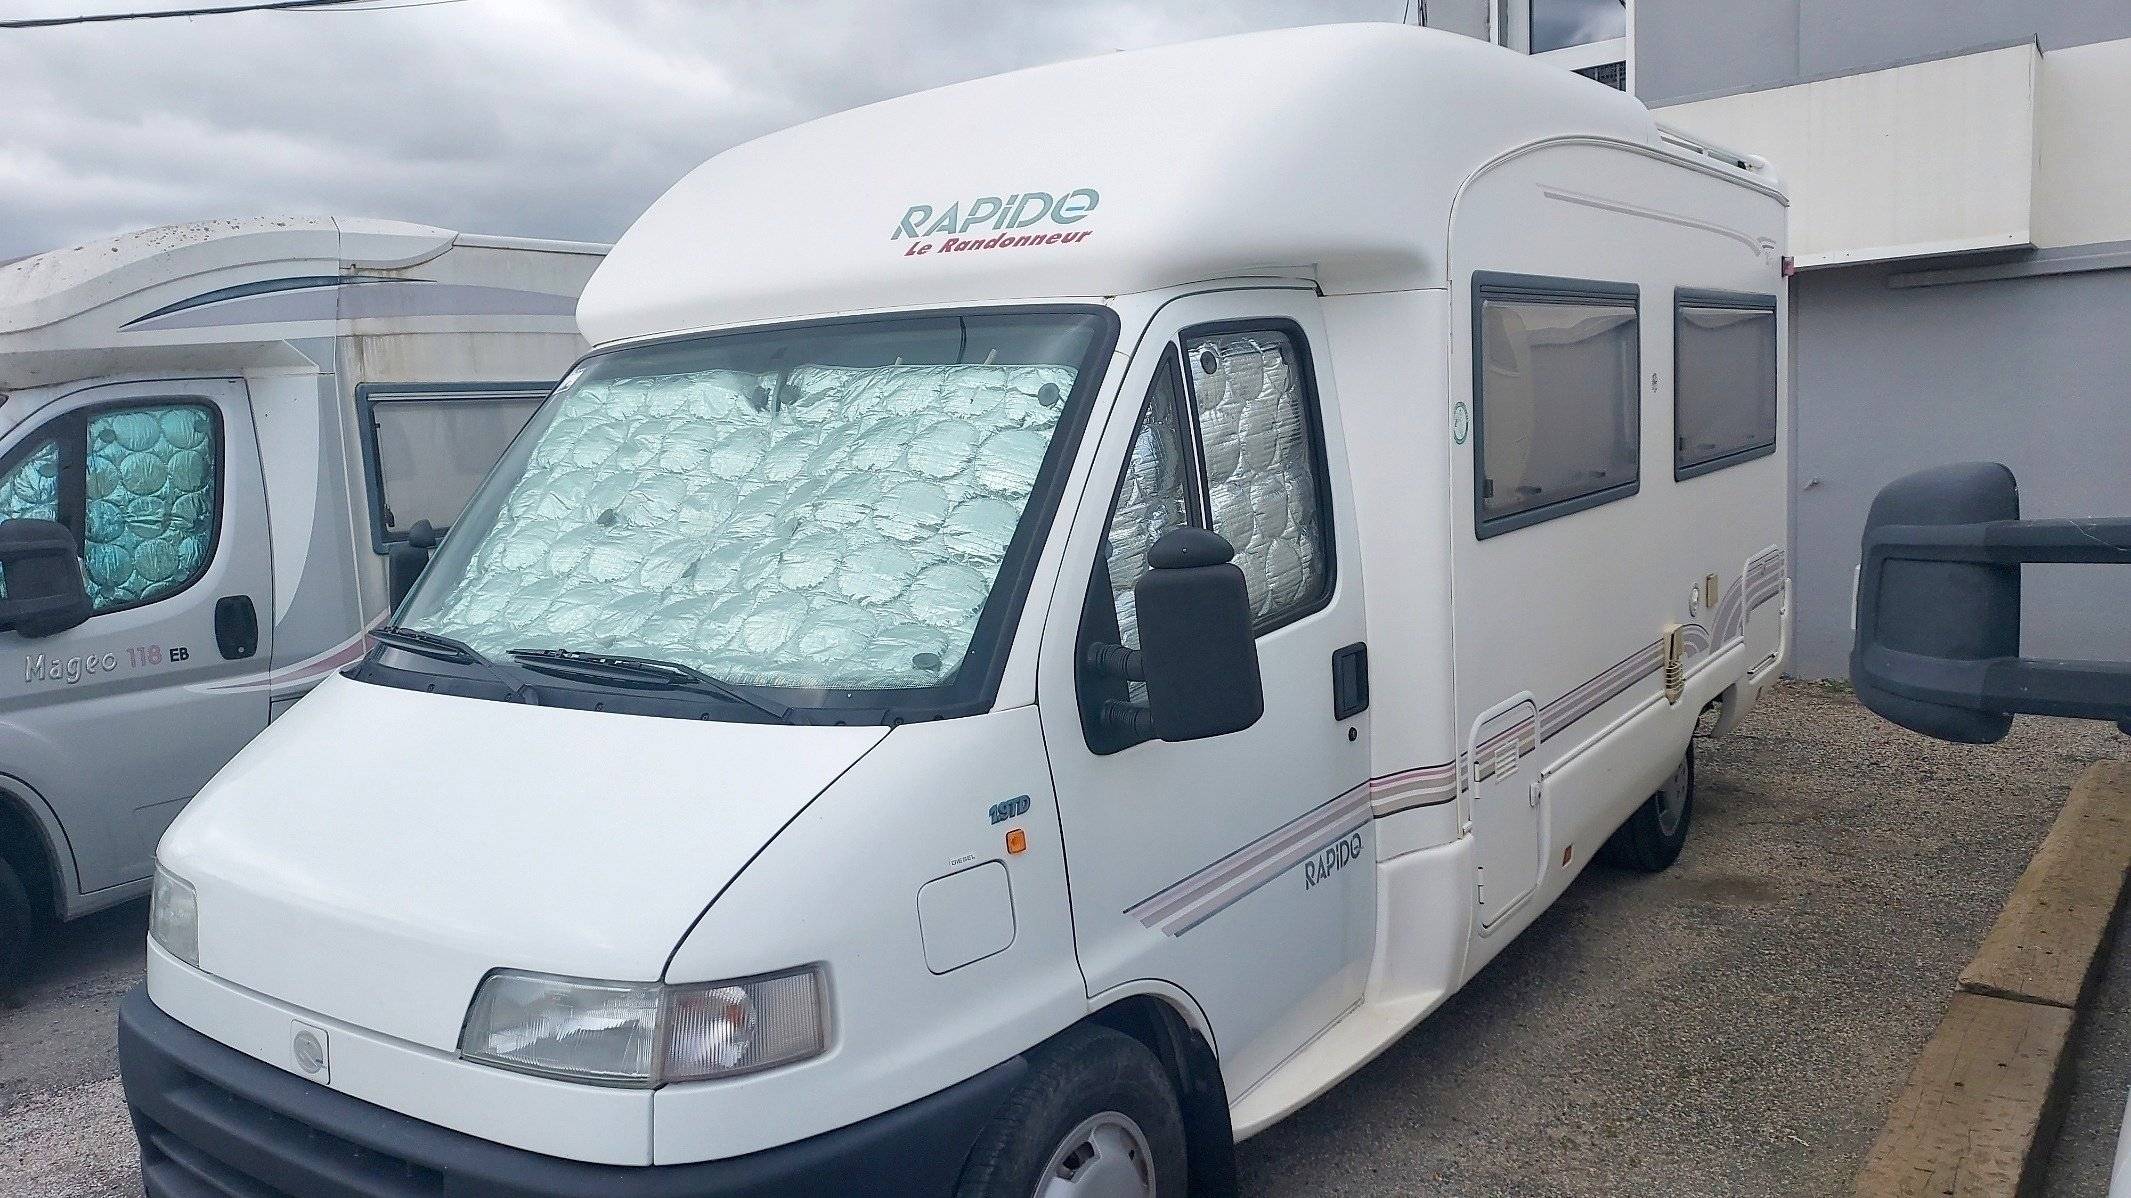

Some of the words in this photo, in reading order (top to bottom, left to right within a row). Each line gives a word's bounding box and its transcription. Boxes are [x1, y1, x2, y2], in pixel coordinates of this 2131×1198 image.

[904, 240, 933, 257] Le
[937, 231, 1094, 254] Randonneur
[25, 651, 118, 685] Mageo
[126, 644, 163, 668] 118
[169, 646, 190, 663] EB
